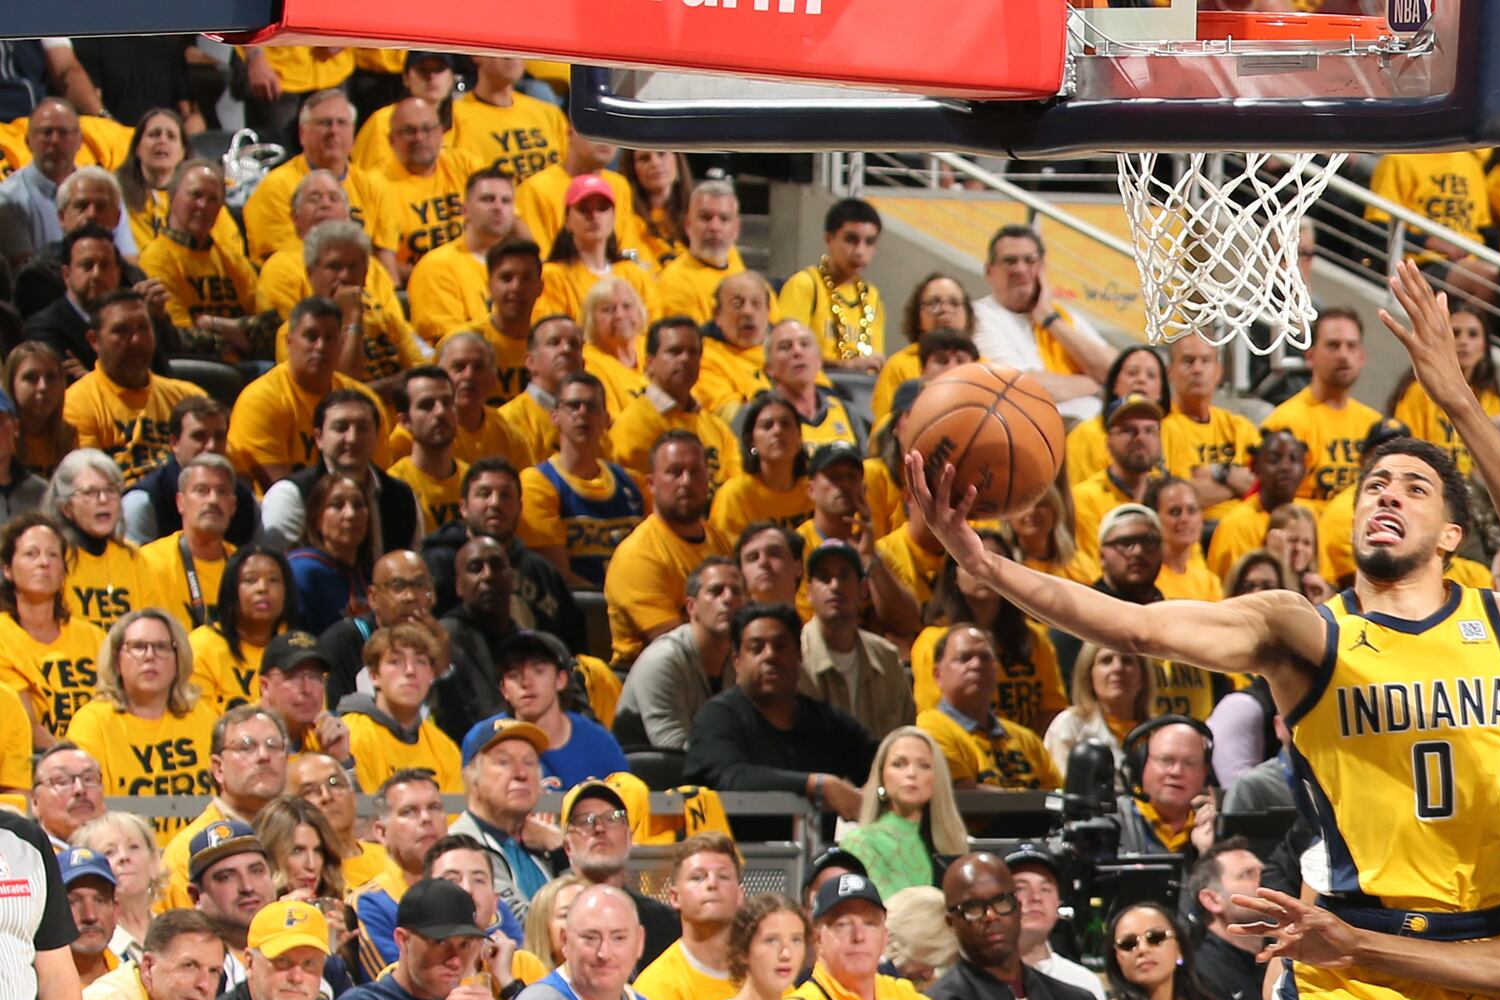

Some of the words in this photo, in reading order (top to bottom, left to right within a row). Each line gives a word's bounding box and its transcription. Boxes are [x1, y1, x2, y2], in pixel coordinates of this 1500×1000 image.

[493, 128, 549, 152] YES
[1431, 174, 1469, 195] YES
[73, 586, 131, 617] YES
[39, 657, 98, 688] YES
[130, 738, 198, 774] YES
[1412, 740, 1454, 820] 0
